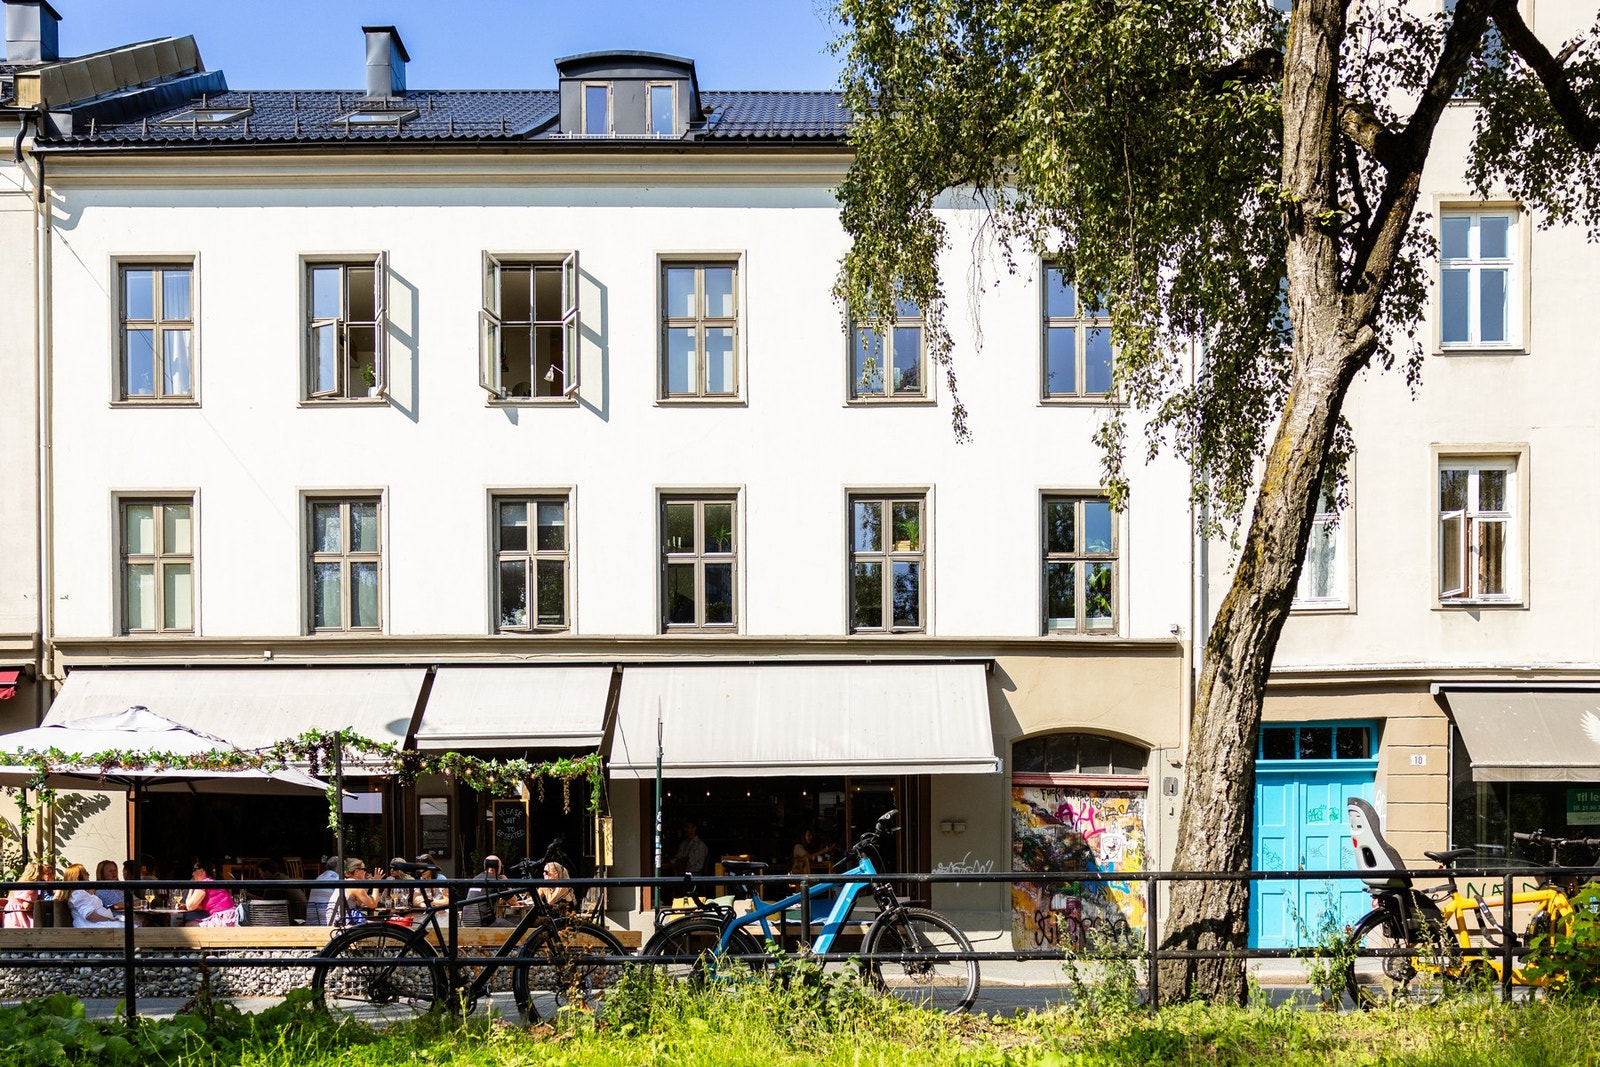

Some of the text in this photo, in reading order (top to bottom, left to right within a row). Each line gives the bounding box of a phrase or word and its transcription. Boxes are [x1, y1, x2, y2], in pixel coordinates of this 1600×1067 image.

[1414, 755, 1423, 765] 10
[1576, 792, 1588, 802] Til
[497, 807, 523, 818] PLEASE
[496, 829, 525, 840] BE SEATED
